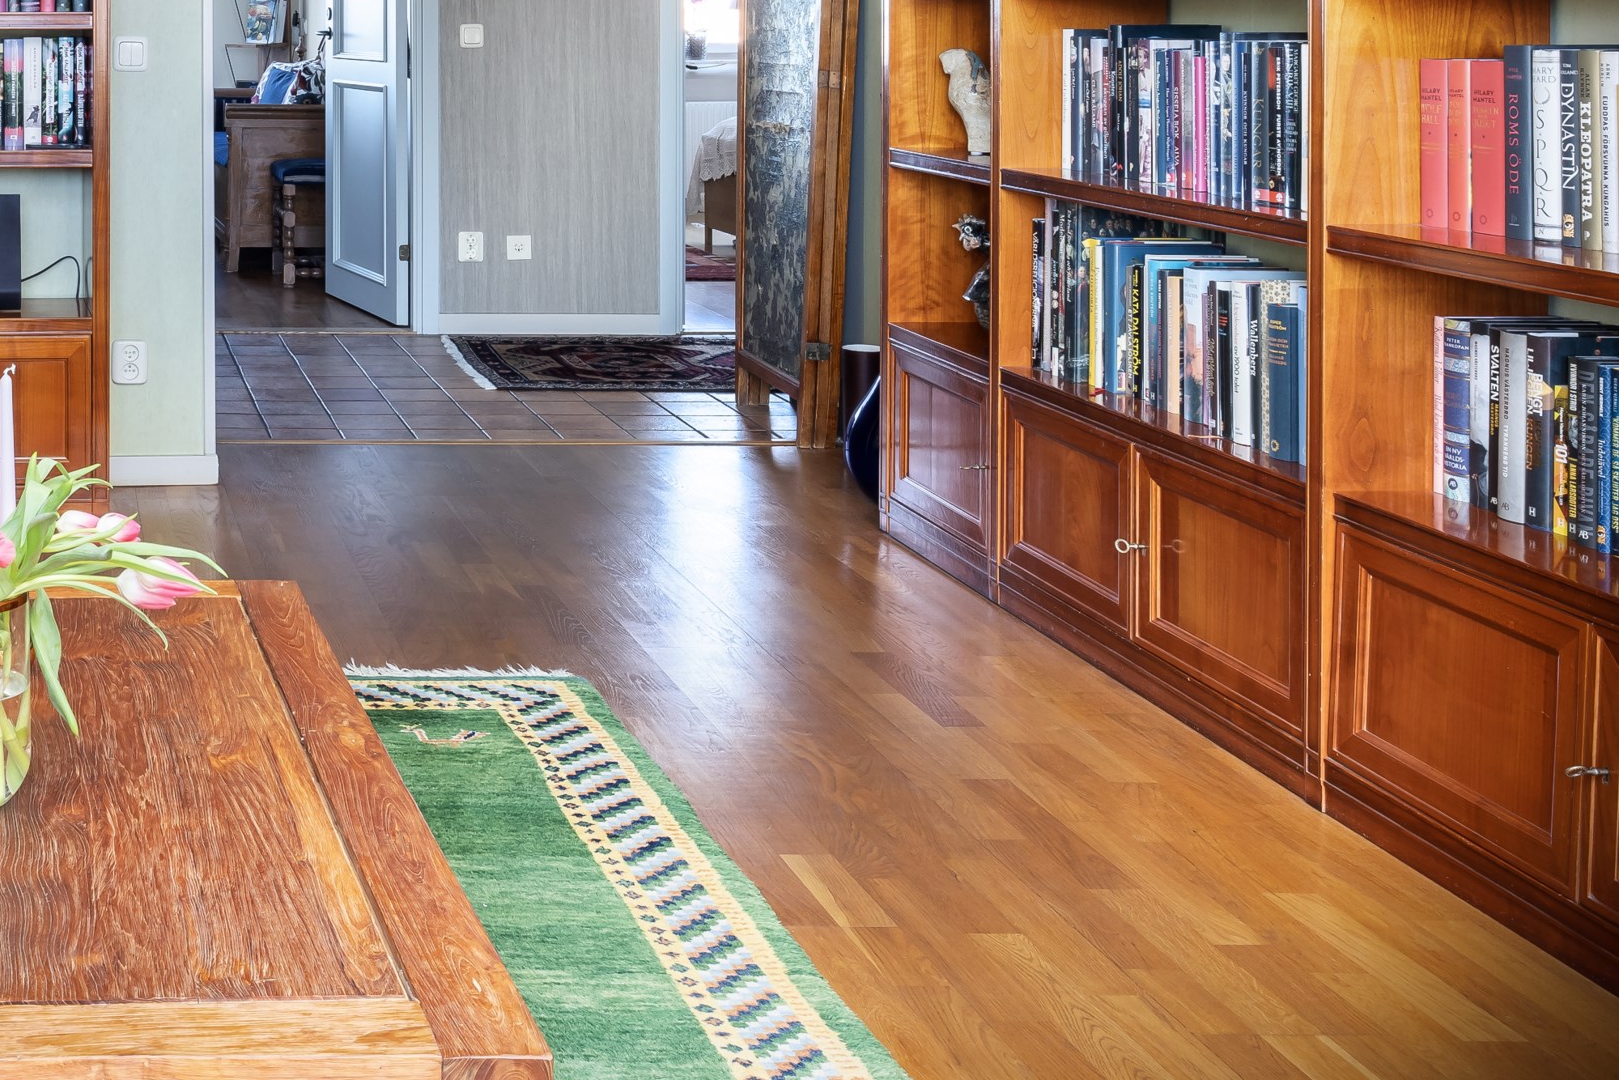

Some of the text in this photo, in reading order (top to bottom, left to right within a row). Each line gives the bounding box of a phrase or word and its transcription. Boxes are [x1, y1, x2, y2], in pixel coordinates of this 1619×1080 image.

[1252, 97, 1265, 169] KUNGAR
[1508, 93, 1522, 195] ROMS ÖDE
[1560, 82, 1579, 191] DYNASTIN
[1579, 101, 1593, 223] KLEOPATRA
[1602, 133, 1610, 181] FÖRSVUNNA
[1602, 184, 1610, 228] KUNGAHUS
[1132, 288, 1142, 376] KATA DALSTRÖM
[1249, 319, 1259, 377] Wallenberg
[1490, 344, 1500, 402] SVALTEN
[1503, 379, 1511, 420] VÄSTERBRO
[1532, 373, 1544, 417] BENGT
[1526, 347, 1534, 471] LILJEGREN KUNGEN
[1556, 443, 1568, 464] 101
[1568, 363, 1578, 518] KVINNOR STRID ANNA LARSDOTTER
[1597, 439, 1606, 478] Judejävel
